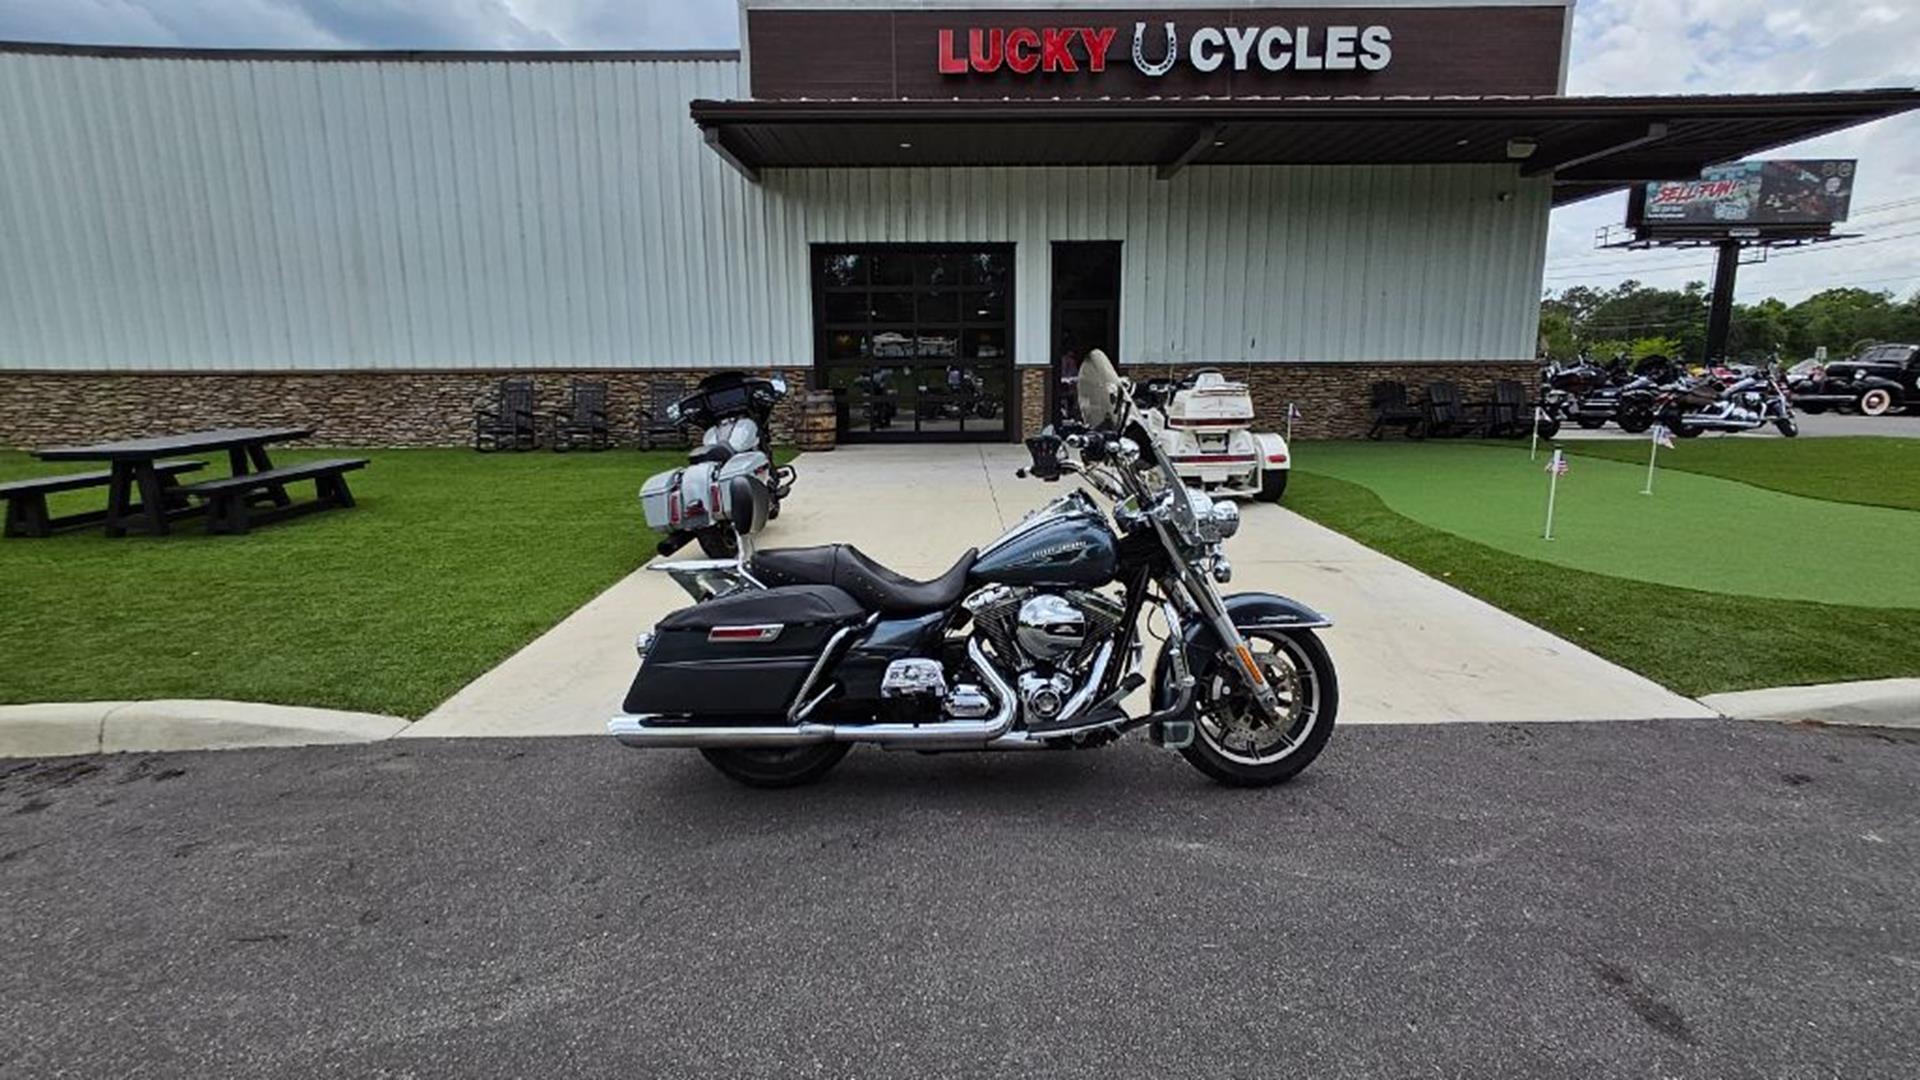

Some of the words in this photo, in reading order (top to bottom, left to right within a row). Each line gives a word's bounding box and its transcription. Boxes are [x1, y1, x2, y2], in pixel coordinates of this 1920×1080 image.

[938, 27, 1117, 73] LUCKY
[1190, 26, 1392, 72] CYCLES
[1654, 185, 1697, 203] SELL
